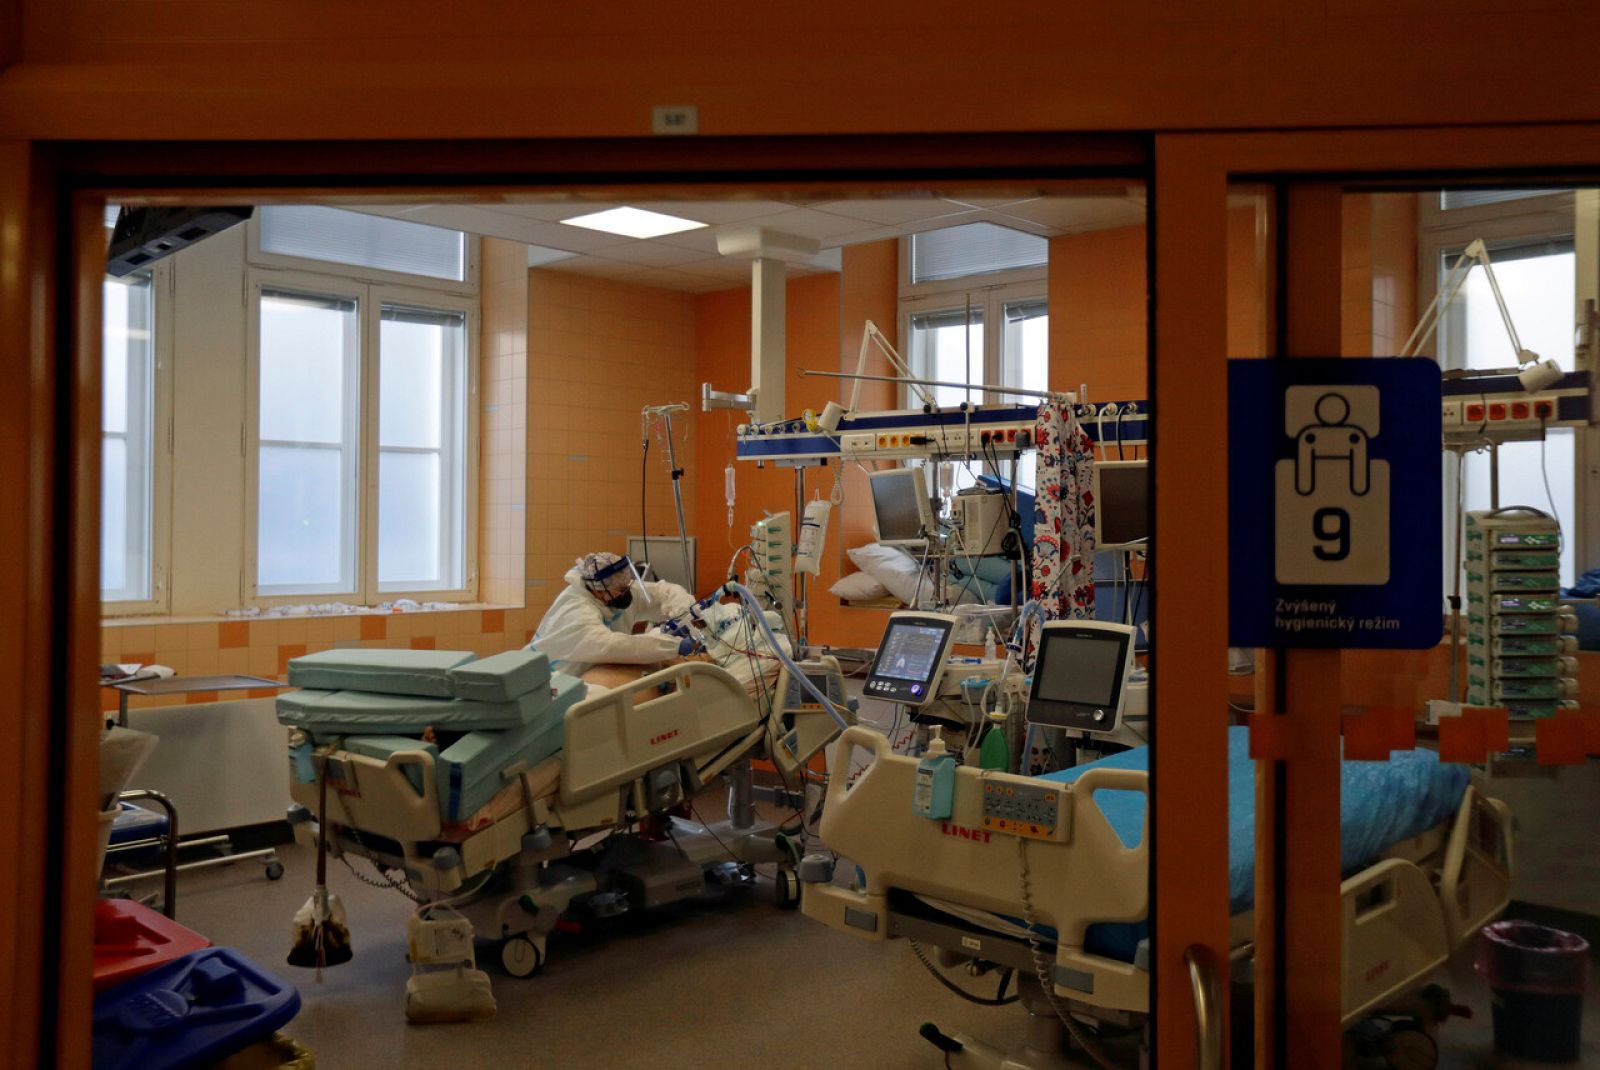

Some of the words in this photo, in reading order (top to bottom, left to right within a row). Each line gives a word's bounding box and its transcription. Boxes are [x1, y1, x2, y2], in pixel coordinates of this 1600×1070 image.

[1313, 507, 1350, 561] 9
[1275, 597, 1336, 615] Zvýšený
[1275, 614, 1355, 632] hygienický
[1359, 616, 1400, 630] režim
[942, 822, 991, 843] LINET
